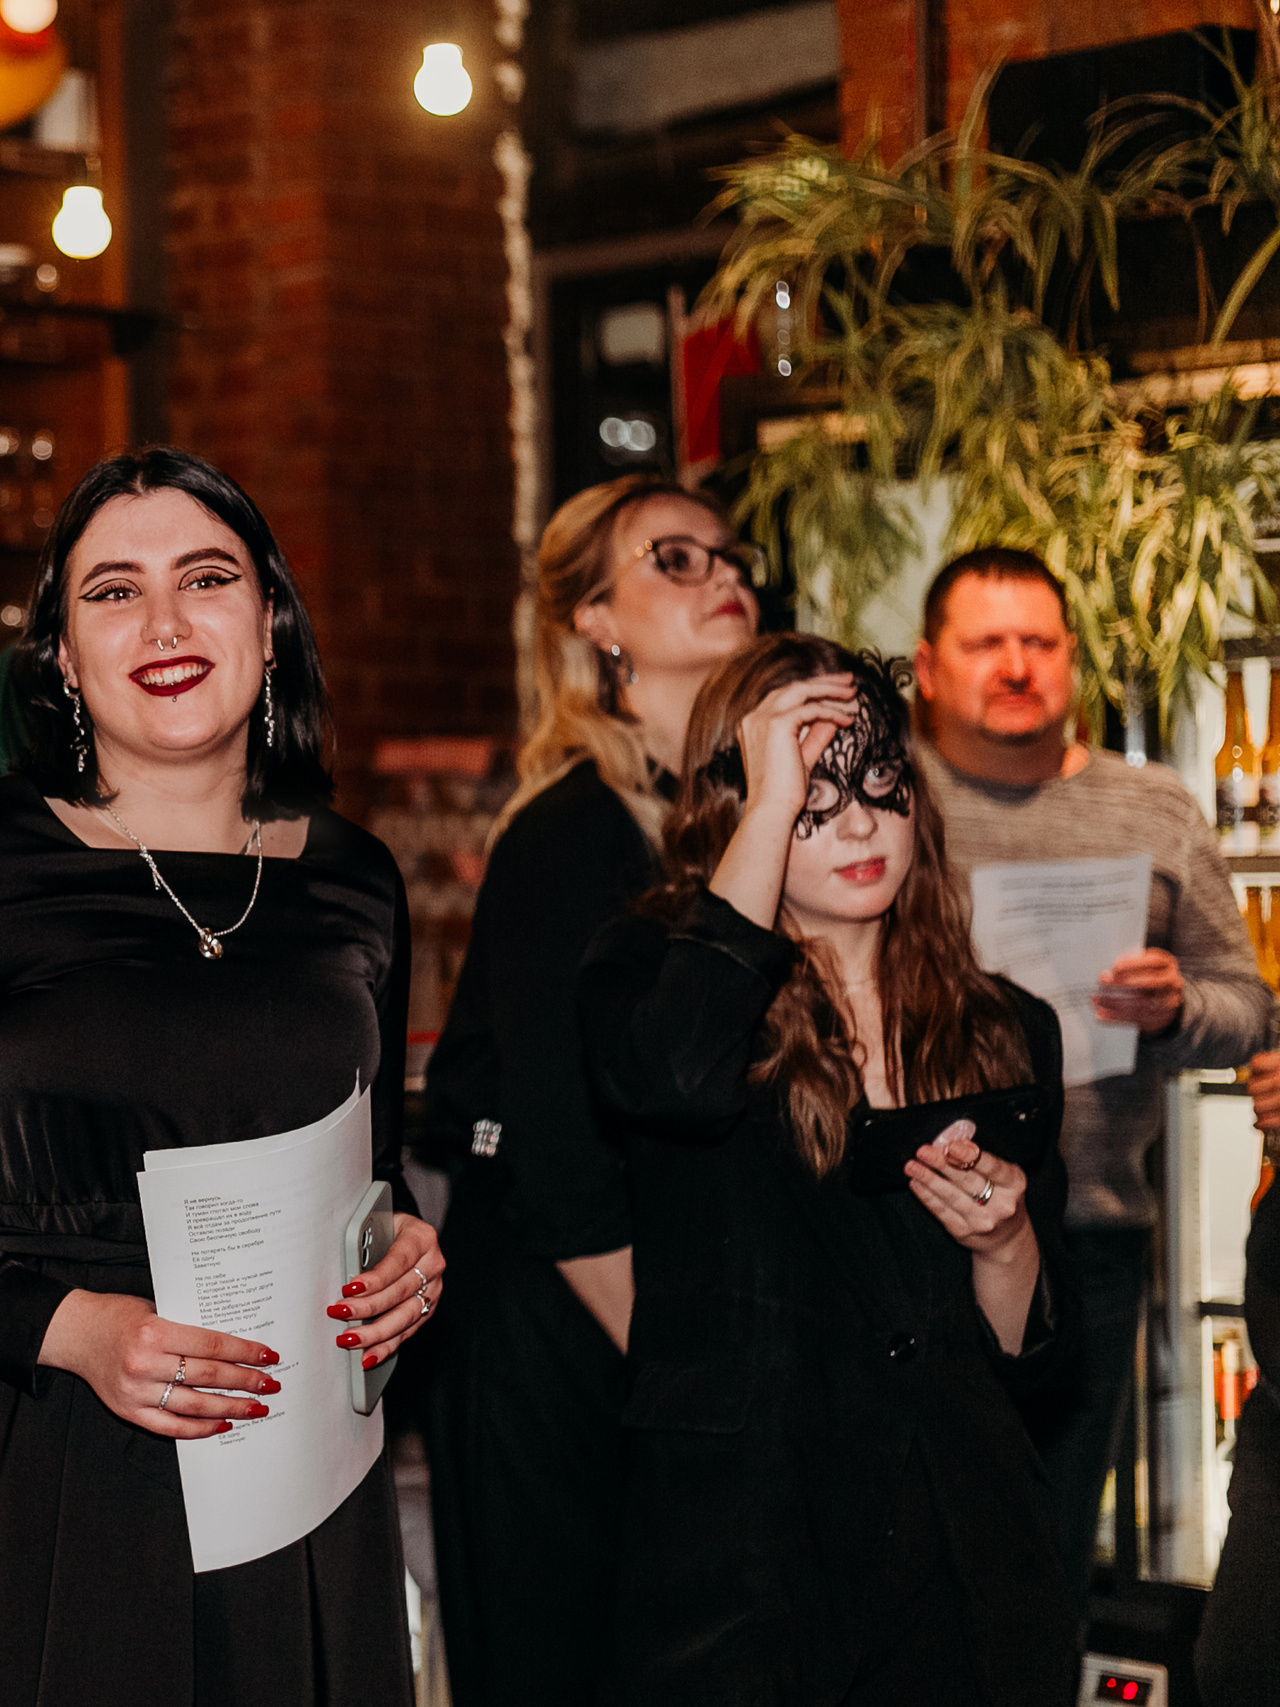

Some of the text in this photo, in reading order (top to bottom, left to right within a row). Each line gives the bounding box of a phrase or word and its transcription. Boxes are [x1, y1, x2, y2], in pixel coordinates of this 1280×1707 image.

[193, 1215, 225, 1223] превращал
[231, 1213, 268, 1224] продолжение
[239, 1228, 261, 1236] свободу
[242, 1240, 264, 1248] серебре
[194, 1261, 220, 1269] Заветную
[241, 1273, 257, 1281] чужой
[222, 1302, 250, 1310] добраться
[252, 1296, 272, 1304] никогда
